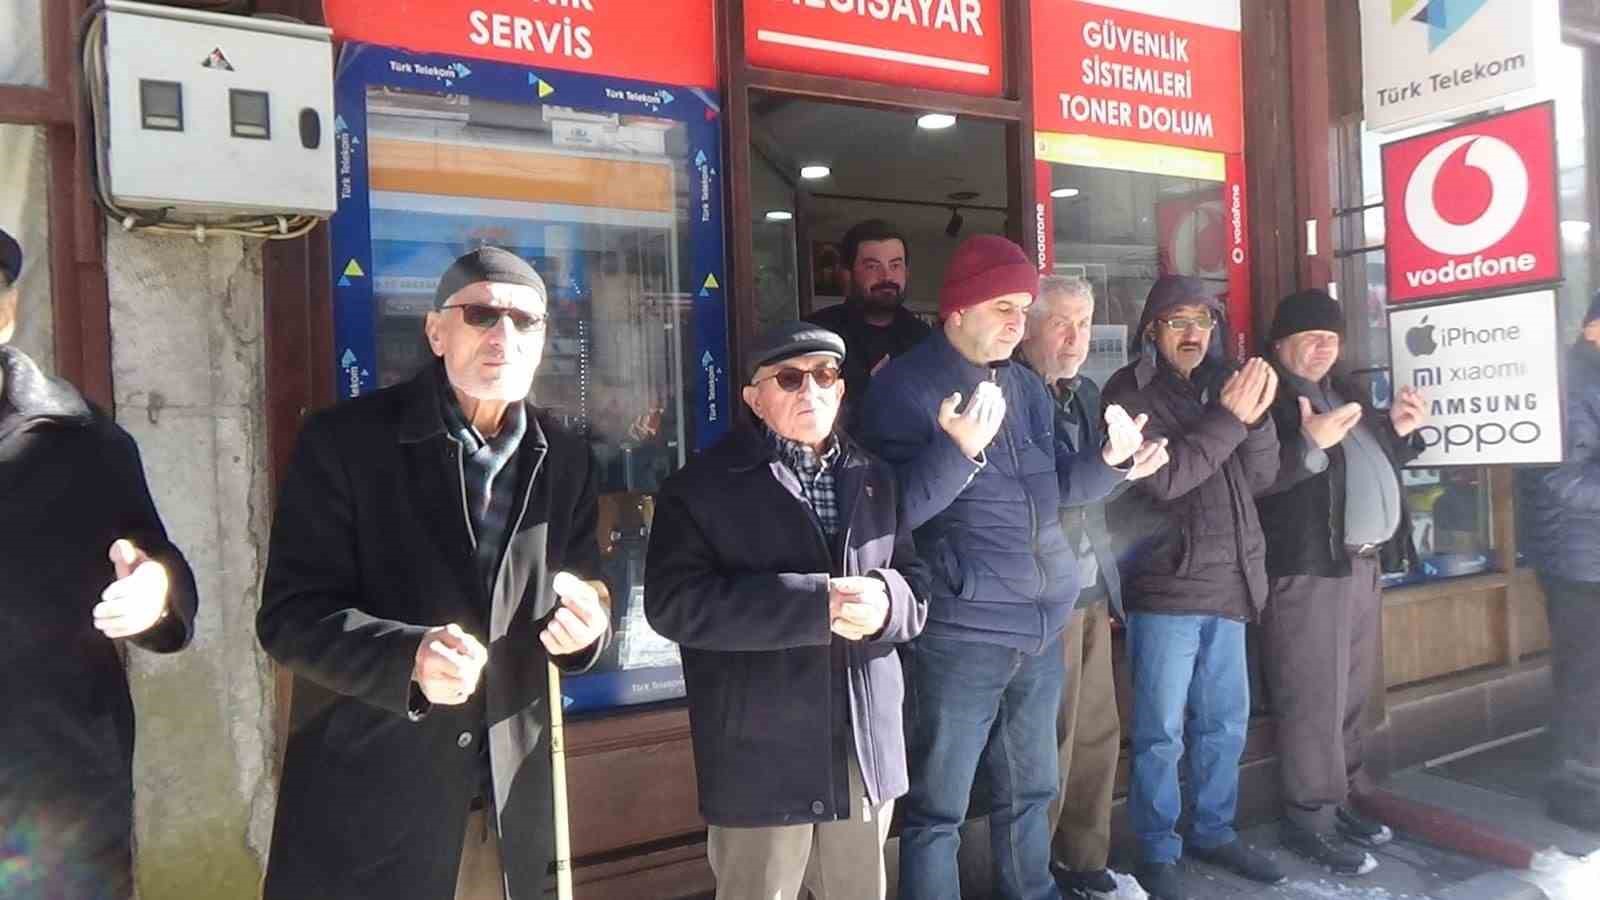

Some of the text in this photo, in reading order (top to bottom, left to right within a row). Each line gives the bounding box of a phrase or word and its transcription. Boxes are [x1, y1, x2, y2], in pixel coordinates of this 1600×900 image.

[469, 10, 593, 60] SERVİS
[1082, 18, 1190, 63] GÜVENLİK
[414, 64, 456, 78] Telekom
[1081, 54, 1192, 99] SİSTEMLERİ
[1377, 53, 1526, 107] Türk Telekom
[1059, 93, 1214, 138] TONER DOLUM
[1036, 203, 1046, 270] vodafone
[1231, 184, 1242, 245] vodafone
[1406, 253, 1536, 288] vodafone
[1441, 325, 1521, 347] iPhone
[1449, 360, 1527, 382] xiaomi
[1431, 393, 1538, 417] AMSUNG
[1415, 421, 1541, 453] oppo
